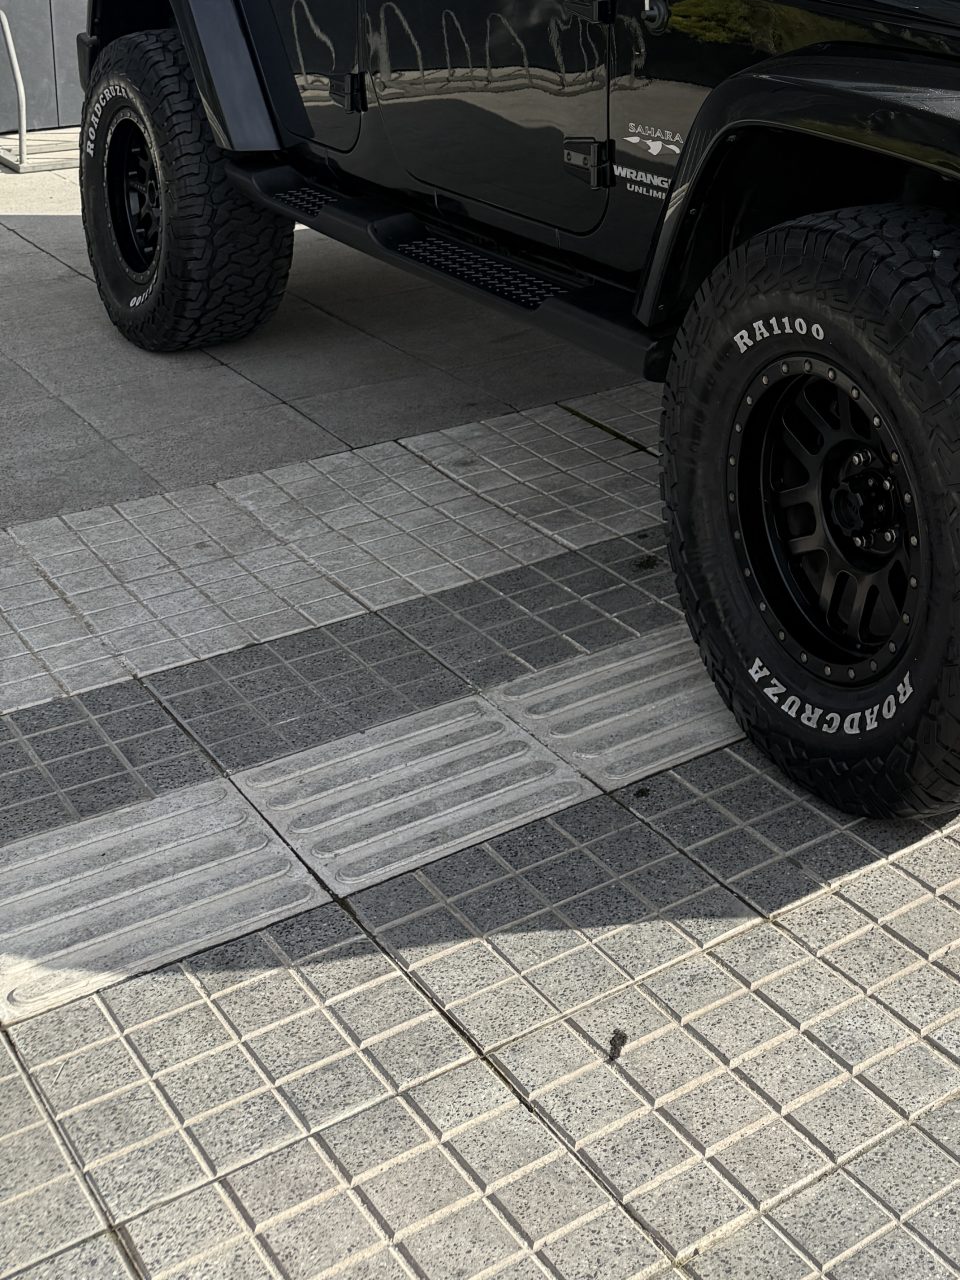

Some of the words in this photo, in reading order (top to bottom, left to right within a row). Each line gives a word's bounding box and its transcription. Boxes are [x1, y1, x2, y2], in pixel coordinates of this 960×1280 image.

[86, 85, 128, 158] ROADCRUZA
[627, 122, 684, 144] SAHARA
[613, 164, 672, 189] WRANG
[733, 316, 825, 354] RA1100
[748, 657, 914, 735] ROADCRUZA
